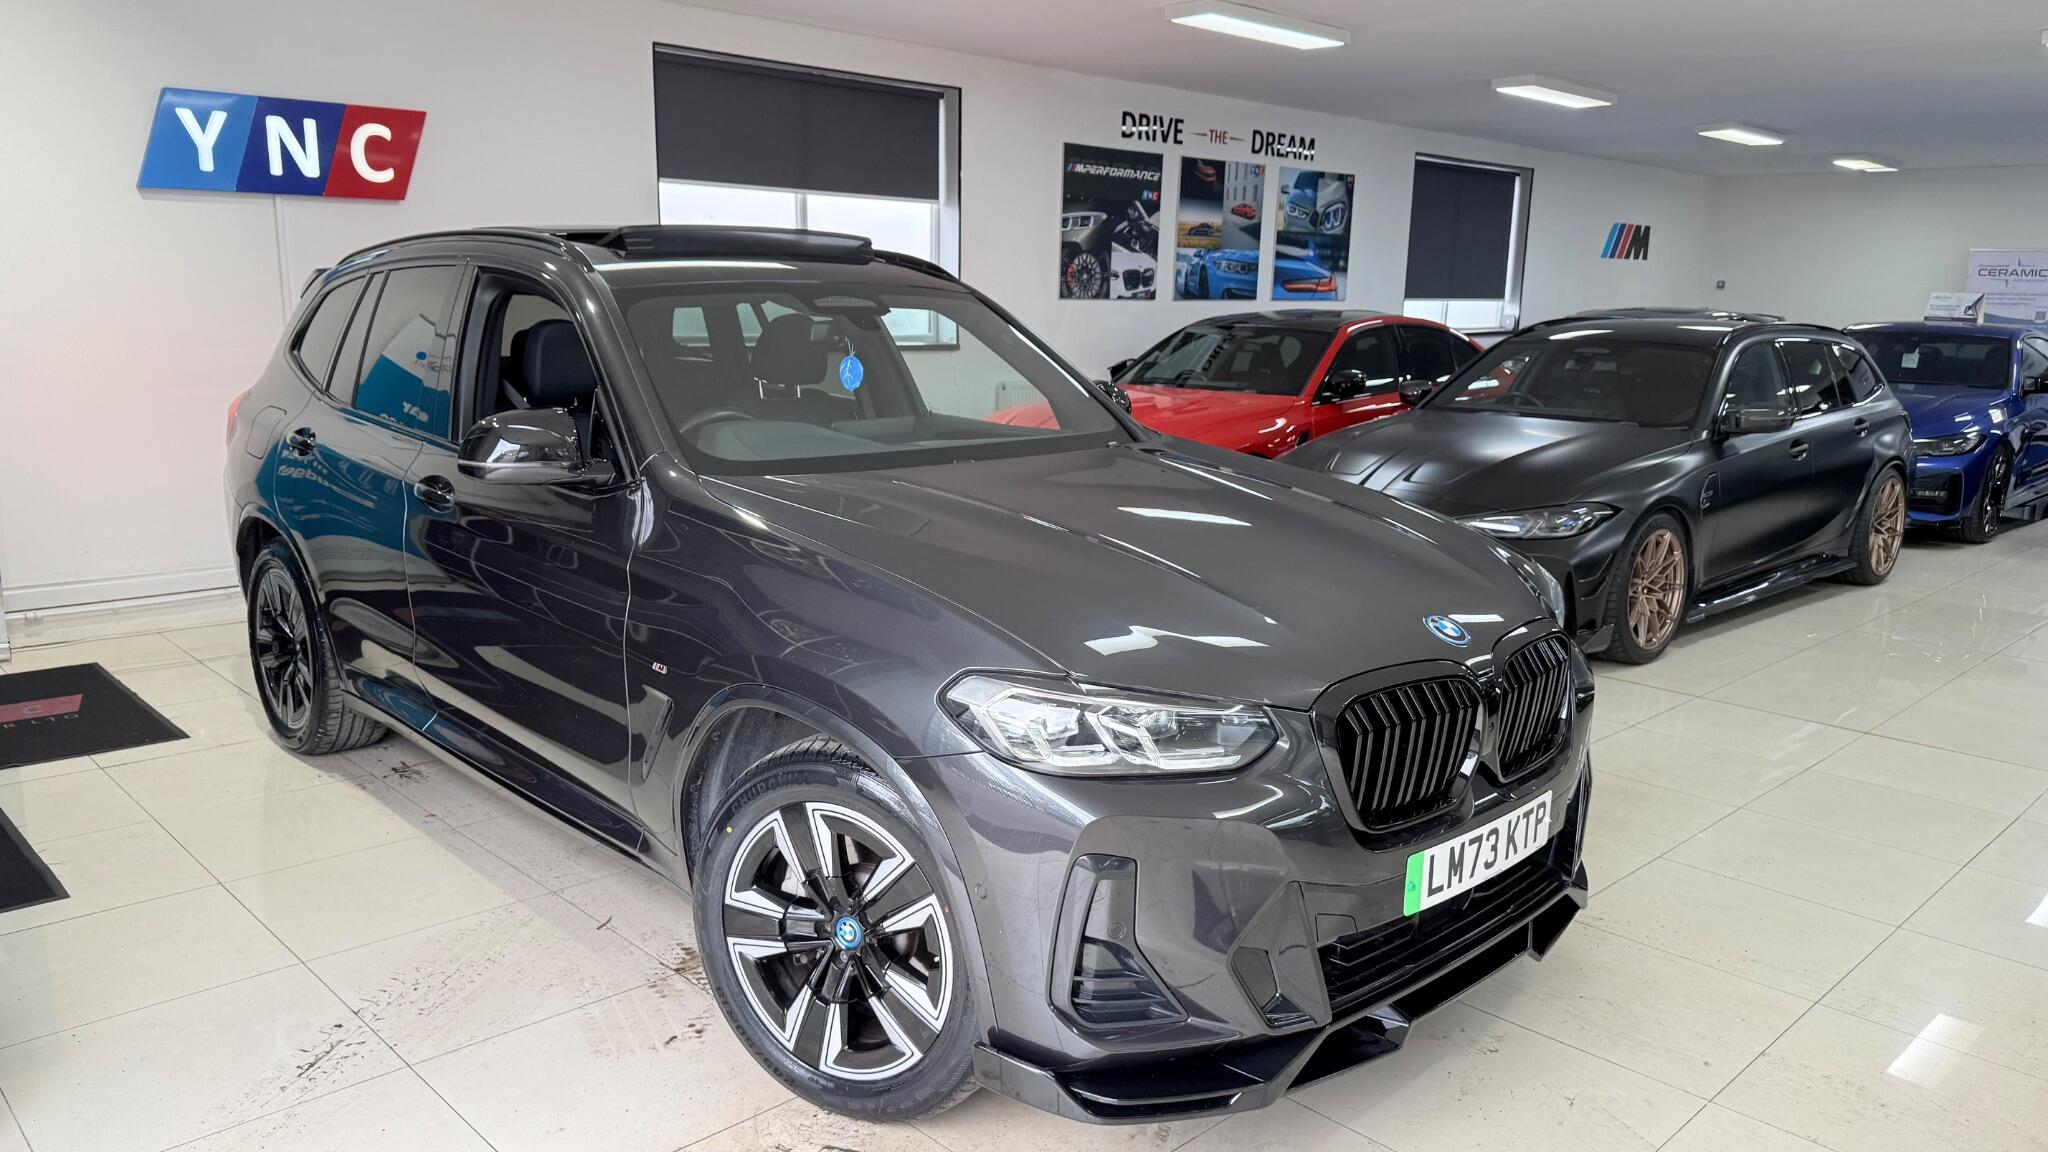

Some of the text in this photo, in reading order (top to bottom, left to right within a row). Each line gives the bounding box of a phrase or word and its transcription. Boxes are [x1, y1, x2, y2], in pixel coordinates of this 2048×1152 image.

[175, 107, 395, 183] YNC
[1121, 111, 1315, 161] DRIVE THE DREAM
[1978, 268, 2048, 277] CERAMIC
[1427, 800, 1547, 898] LM73 KTP
